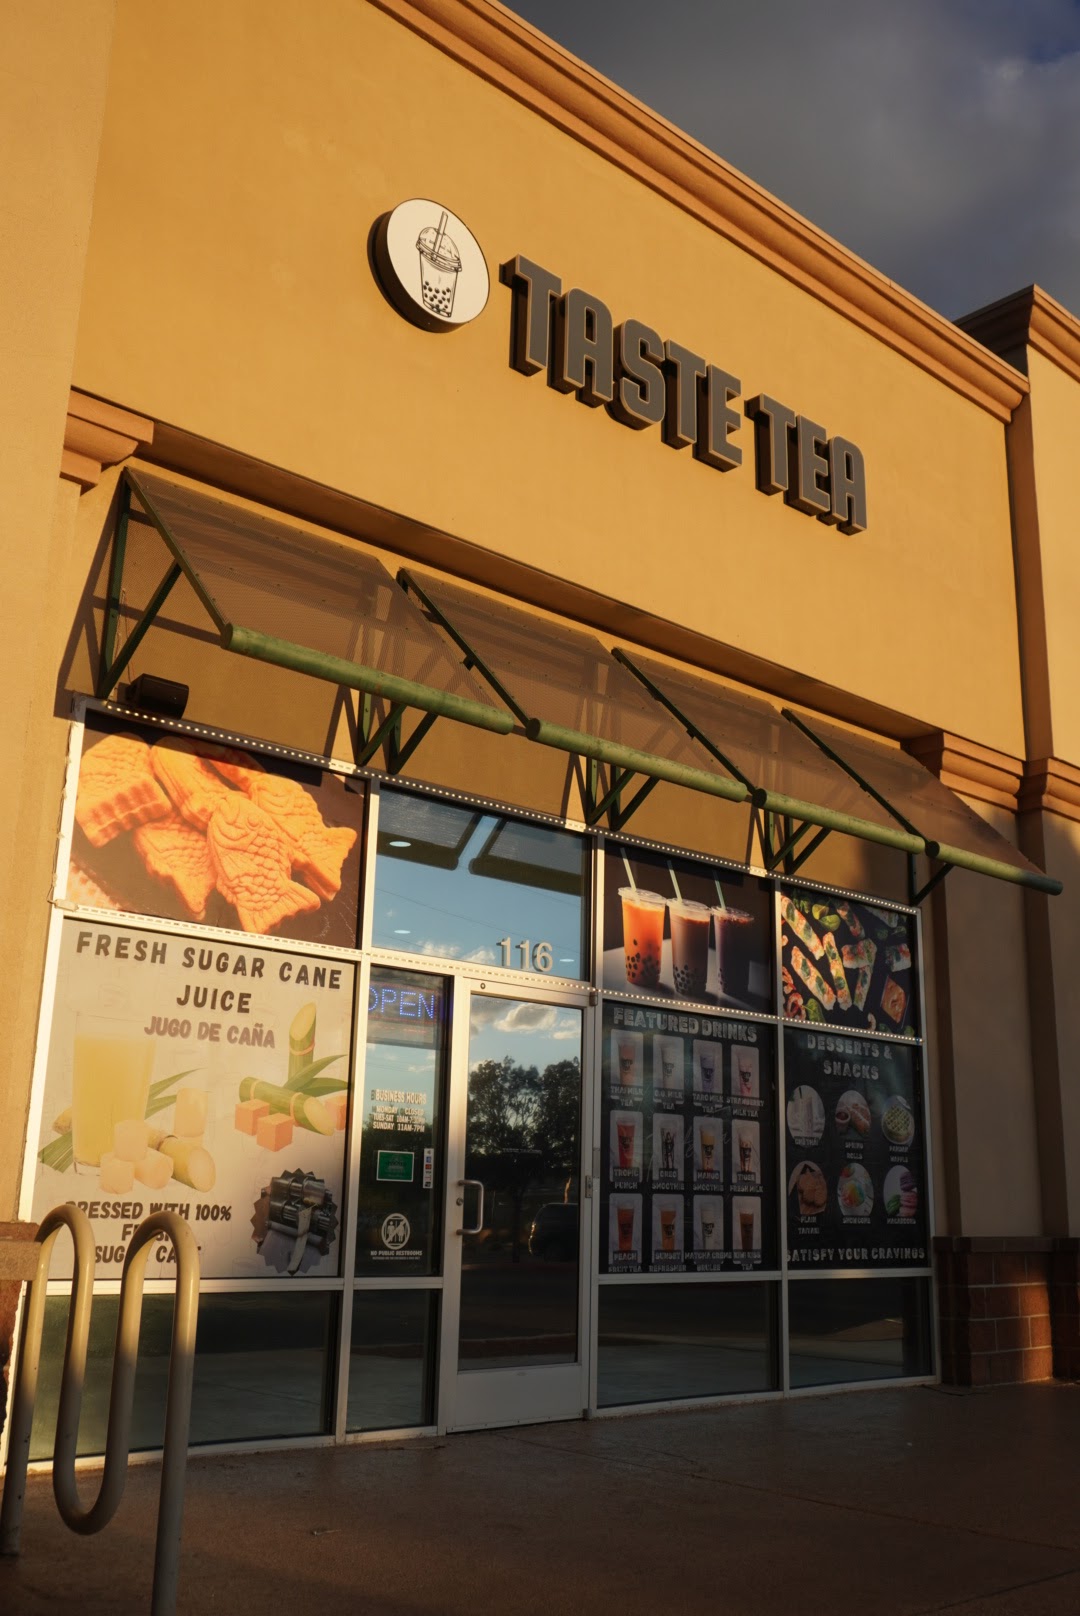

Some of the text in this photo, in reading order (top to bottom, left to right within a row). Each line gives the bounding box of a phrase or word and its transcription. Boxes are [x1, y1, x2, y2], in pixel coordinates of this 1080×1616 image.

[502, 254, 867, 535] TASTE TEA
[76, 931, 342, 989] FRESH SUGAR CANE
[496, 936, 554, 972] 116
[176, 985, 252, 1014] JUICE
[144, 1016, 276, 1049] JUGO DE CAÑA
[613, 1007, 758, 1042] FEATURED DRINKS
[807, 1034, 893, 1060] DESSERTS &
[823, 1060, 879, 1080] SNACKS
[375, 1088, 427, 1105] BUSINESS HOURS
[626, 1087, 643, 1096] MILK
[667, 1091, 683, 1099] MILK
[693, 1093, 724, 1103] TARO MILK
[376, 1106, 398, 1114] MONDAY
[620, 1099, 634, 1107] TEA
[662, 1102, 675, 1110] TEA
[372, 1121, 425, 1132] SUNDAY 11AM-7PM
[614, 1182, 638, 1190] PUNCH
[652, 1183, 685, 1191] SMOOTHIE
[64, 1201, 143, 1219] RESSED
[195, 1204, 232, 1221] 100%
[94, 1246, 125, 1263] SUG
[838, 1249, 868, 1260] YOUR
[872, 1248, 925, 1260] CRAVINGS
